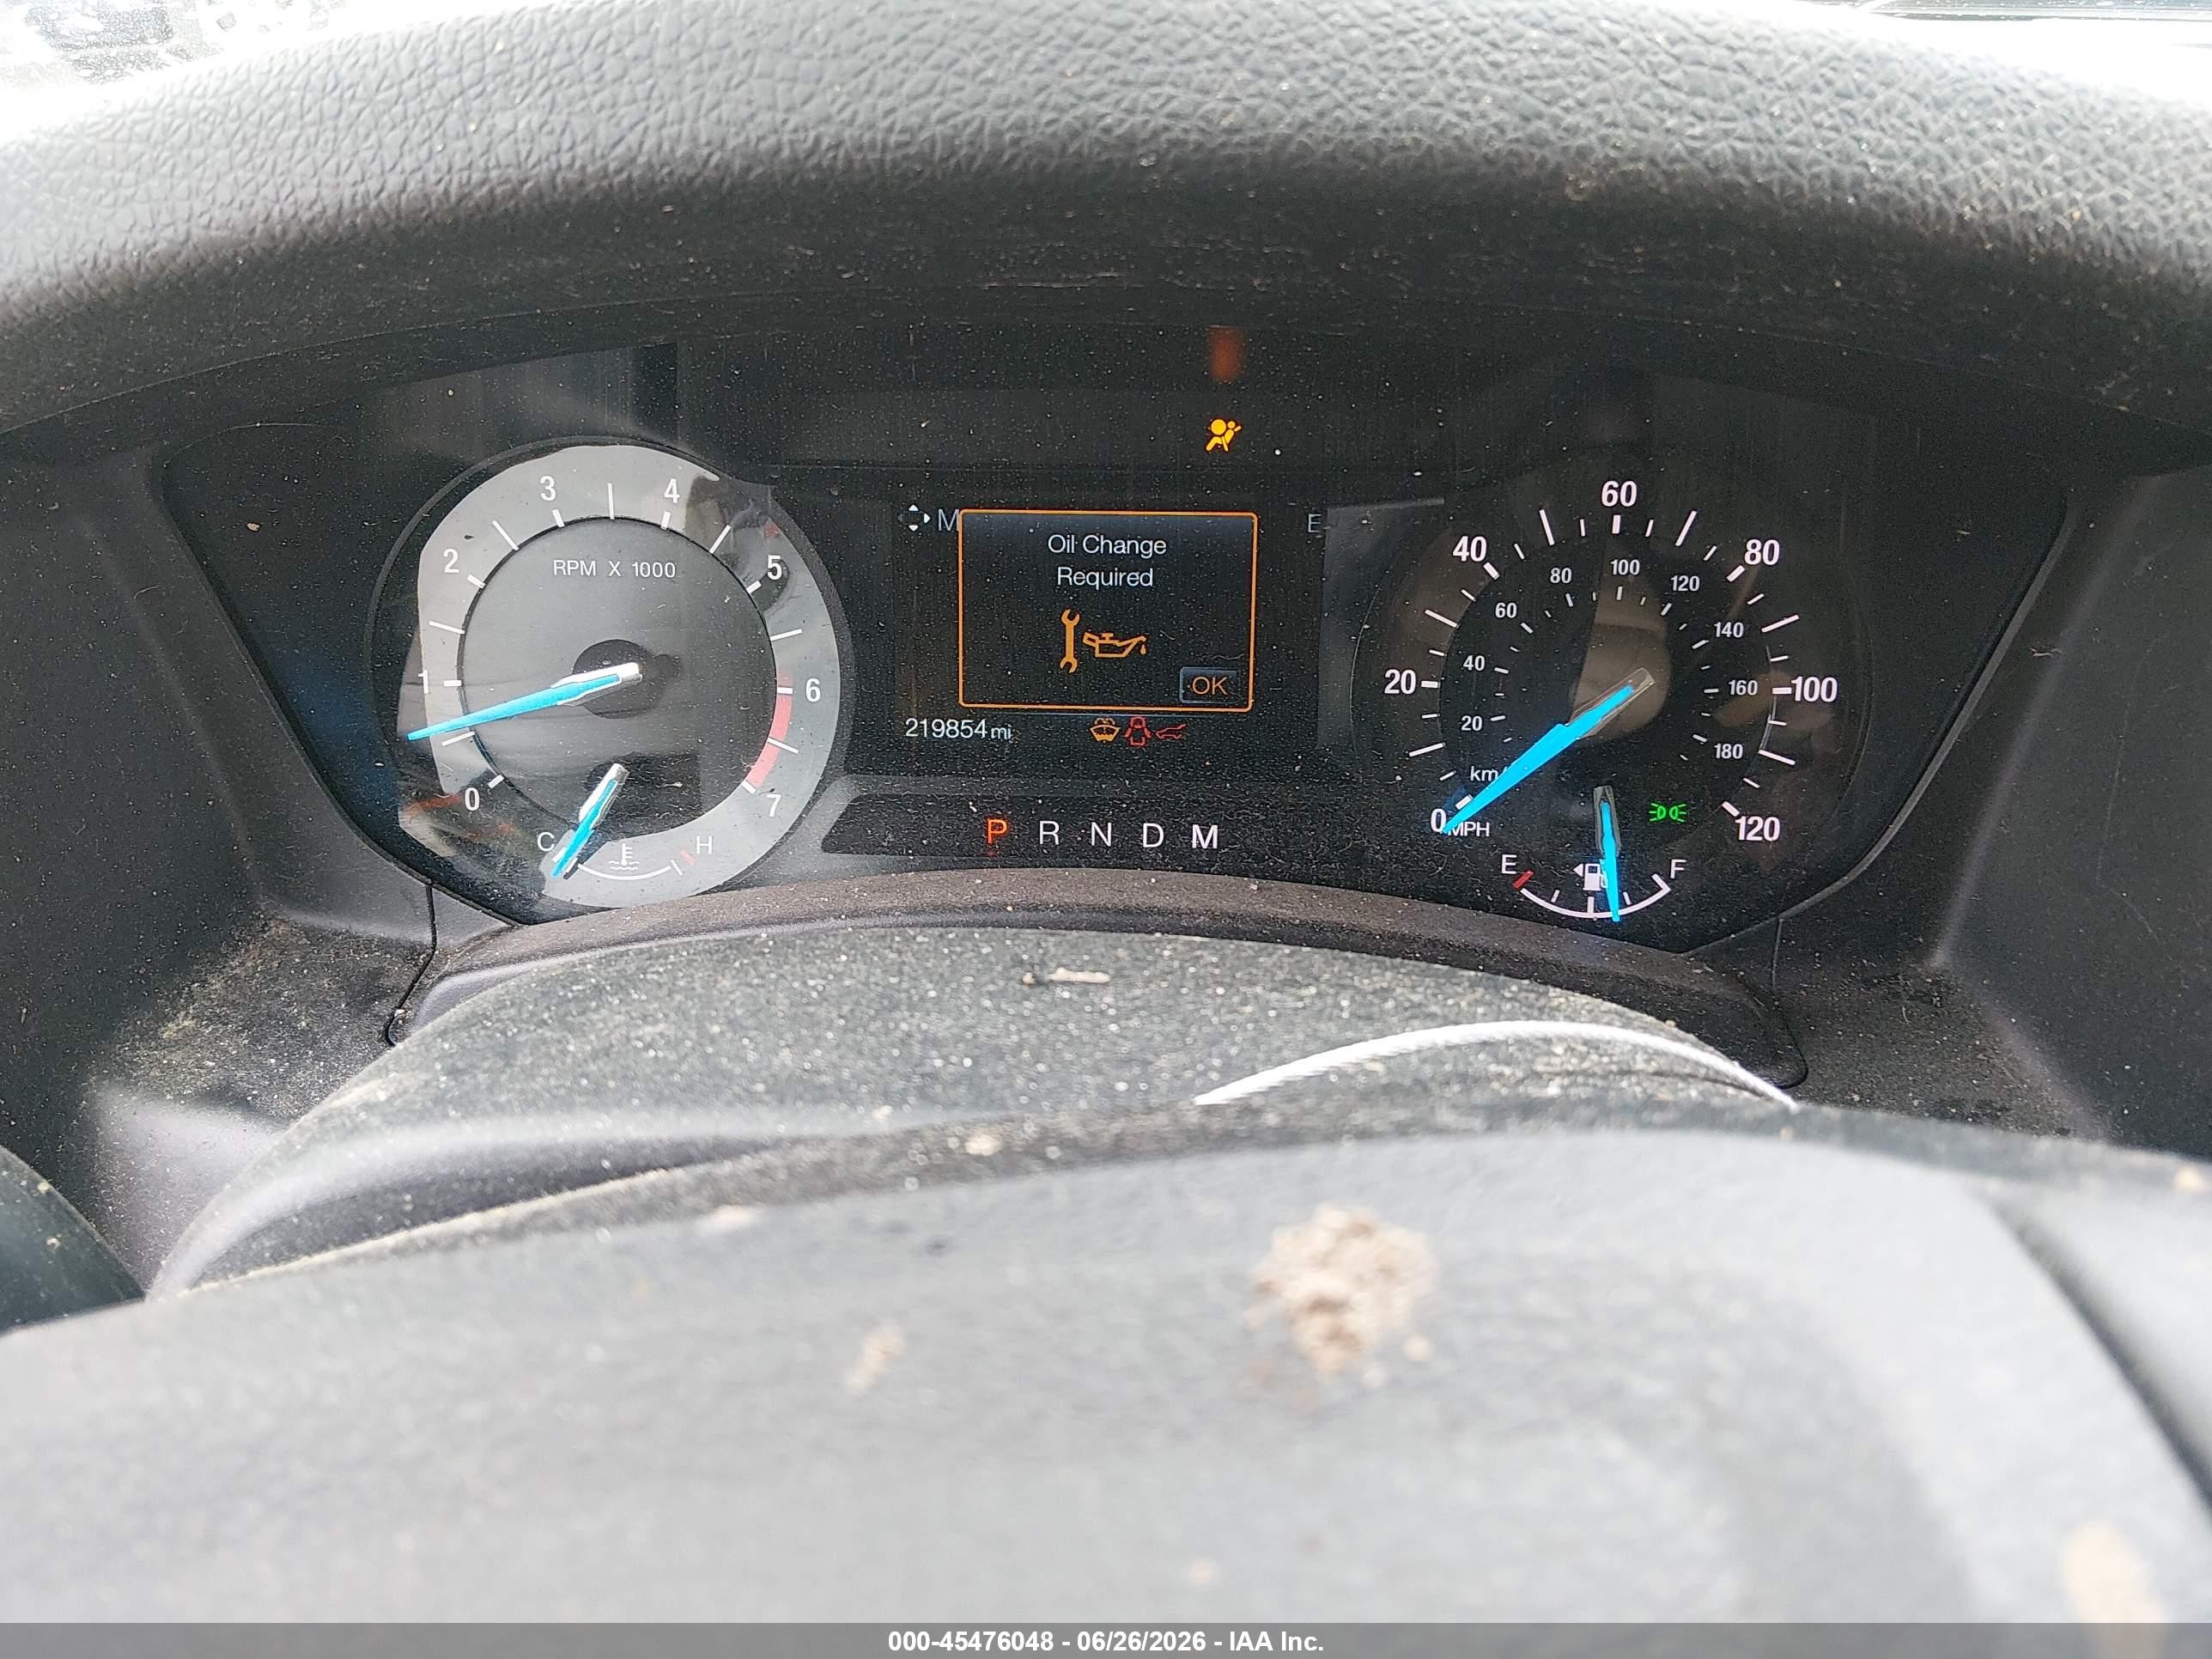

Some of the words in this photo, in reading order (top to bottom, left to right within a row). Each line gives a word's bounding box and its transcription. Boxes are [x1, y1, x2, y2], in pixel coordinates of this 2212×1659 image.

[541, 476, 556, 501] 3
[664, 478, 680, 503] 4
[1602, 481, 1637, 507] 60
[1048, 535, 1075, 554] Oil
[1082, 535, 1167, 558] Change
[1453, 537, 1486, 562] 40
[1745, 539, 1779, 565] 80
[443, 549, 459, 574] 2
[553, 560, 596, 576] RPM
[608, 561, 622, 576] X
[632, 562, 676, 578] 1000
[767, 555, 782, 580] 5
[1610, 560, 1640, 575] 100
[1057, 567, 1153, 590] Required
[1550, 567, 1572, 584] 80
[1670, 574, 1700, 592] 120
[1495, 602, 1517, 618] 60
[1714, 623, 1744, 638] 140
[1462, 655, 1485, 672] 40
[418, 670, 430, 694] 1
[805, 678, 821, 702] 6
[1193, 676, 1228, 695] OK
[1384, 670, 1416, 695] 20
[1729, 679, 1759, 695] 160
[1792, 677, 1838, 702] 100
[1461, 715, 1483, 732] 20
[1714, 743, 1743, 759] 180
[465, 788, 480, 811] 0
[767, 794, 781, 817] 7
[1431, 808, 1447, 833] 0
[1735, 816, 1781, 842] 120
[536, 831, 556, 852] C
[987, 818, 1008, 845] P
[1039, 820, 1060, 845] R
[1091, 822, 1112, 847] N
[1142, 823, 1164, 848] D
[1191, 823, 1218, 849] M
[696, 836, 713, 855] H
[1501, 854, 1517, 874] E
[1670, 860, 1686, 879] F
